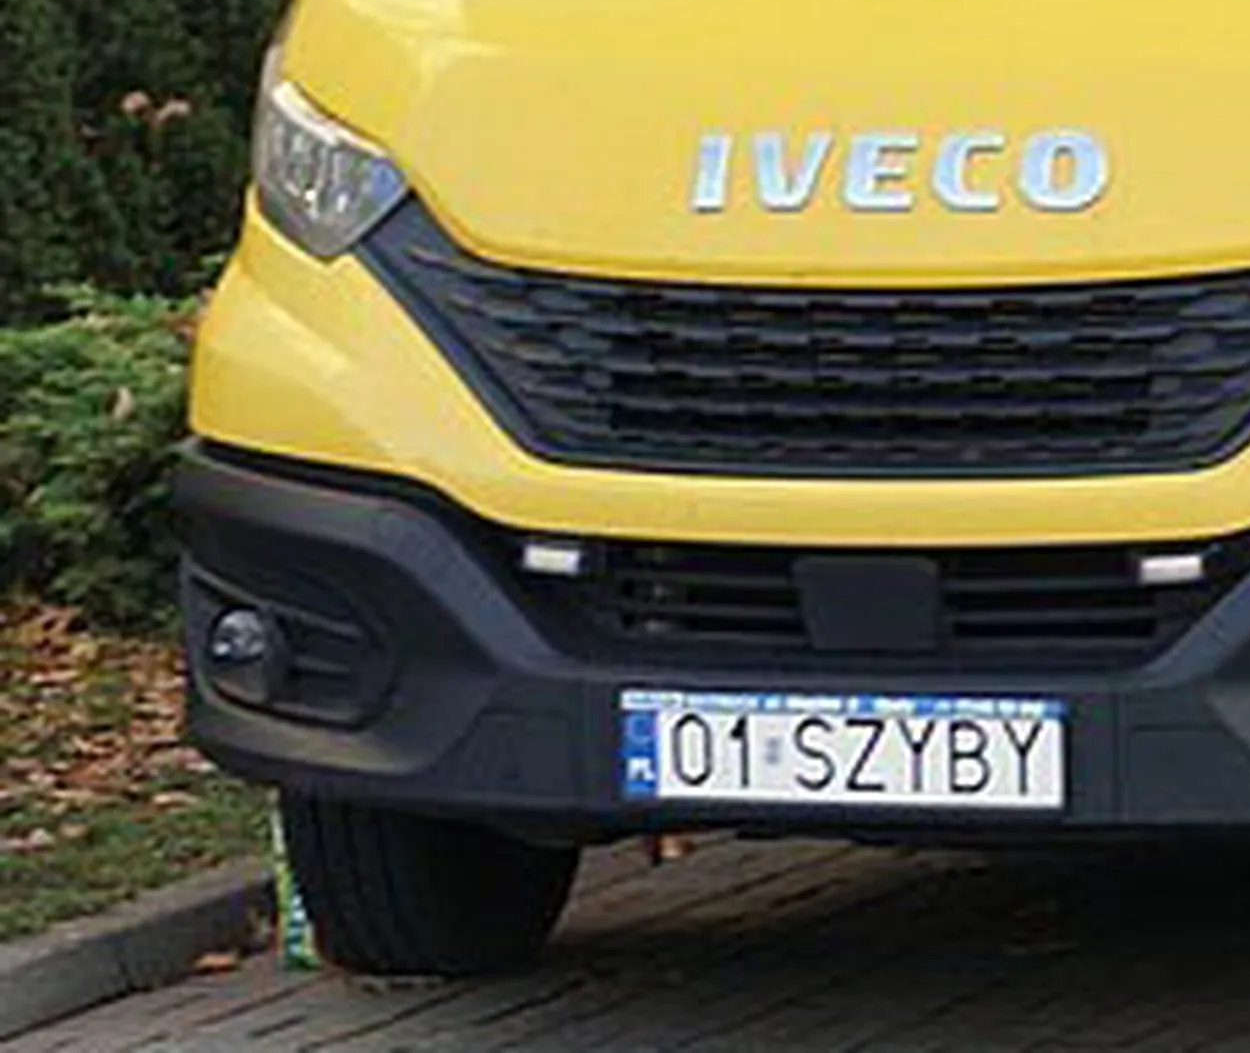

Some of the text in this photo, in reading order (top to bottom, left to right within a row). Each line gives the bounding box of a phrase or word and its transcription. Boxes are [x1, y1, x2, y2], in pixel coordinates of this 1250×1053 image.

[690, 130, 1110, 213] IVECO
[670, 713, 1044, 796] 01 SZYBY
